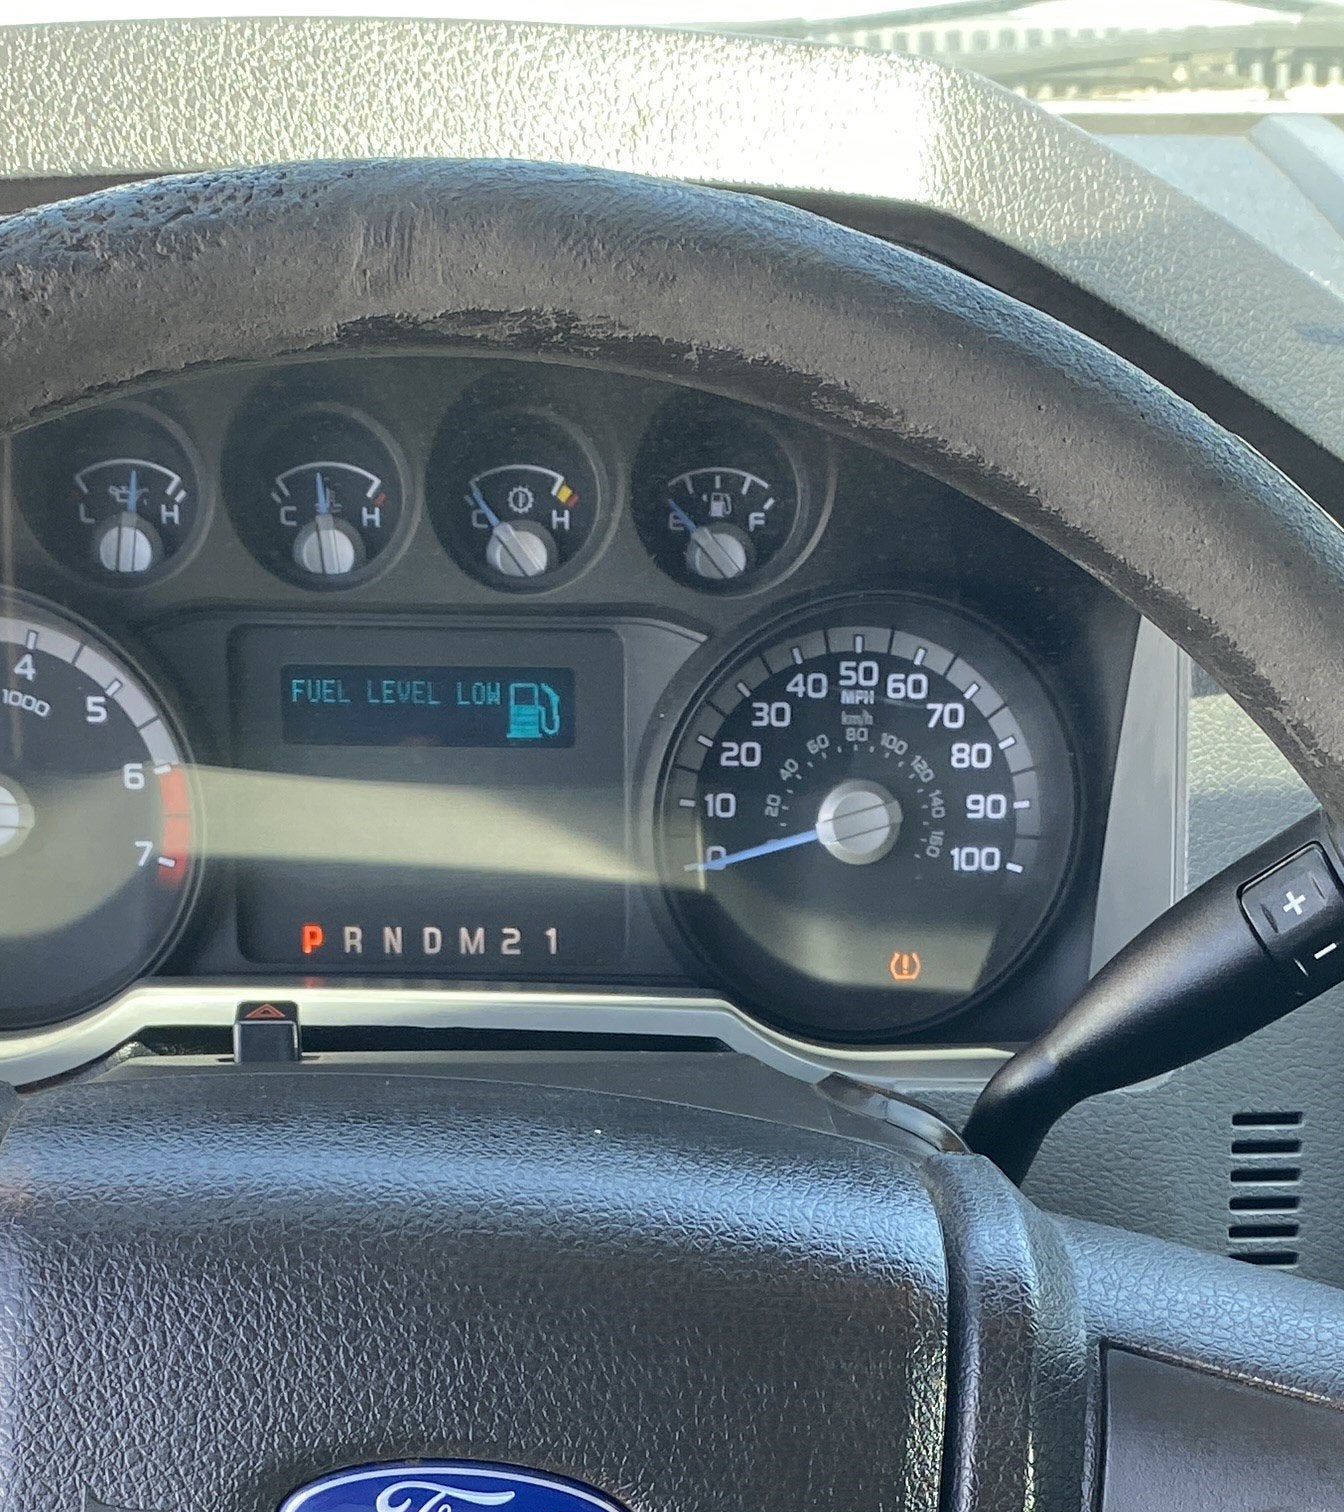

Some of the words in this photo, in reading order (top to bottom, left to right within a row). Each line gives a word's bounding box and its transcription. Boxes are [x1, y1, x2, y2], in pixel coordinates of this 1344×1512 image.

[79, 503, 96, 524] L
[161, 504, 180, 525] H
[279, 506, 297, 526] C
[361, 506, 380, 528] H
[471, 509, 489, 528] C
[551, 509, 570, 530] H
[748, 511, 765, 532] F
[14, 653, 36, 682] 4
[839, 661, 879, 687] 50
[292, 679, 352, 703] FUEL
[367, 679, 441, 705] LEVEL
[456, 681, 501, 705] LOW
[786, 673, 828, 699] 40
[841, 689, 875, 705] MPH
[886, 673, 928, 699] 60
[2, 688, 51, 717] 1000
[86, 696, 107, 723] 5
[751, 701, 791, 727] 30
[926, 702, 965, 729] 70
[807, 734, 830, 755] 60
[846, 727, 869, 742] 80
[880, 733, 908, 755] 100
[720, 741, 762, 767] 20
[951, 742, 992, 769] 80
[123, 763, 145, 790] 6
[780, 758, 798, 781] 40
[910, 755, 935, 783] 120
[704, 793, 736, 819] 10
[765, 794, 781, 817] 20
[929, 789, 946, 819] 140
[966, 793, 1006, 820] 90
[135, 841, 154, 867] 7
[926, 830, 944, 858] 160
[951, 847, 1001, 872] 100
[301, 926, 324, 954] P
[344, 926, 363, 954] R
[383, 926, 402, 955] N
[423, 927, 442, 954] D
[460, 927, 485, 955] M
[501, 928, 522, 955] 2
[545, 928, 557, 955] 1
